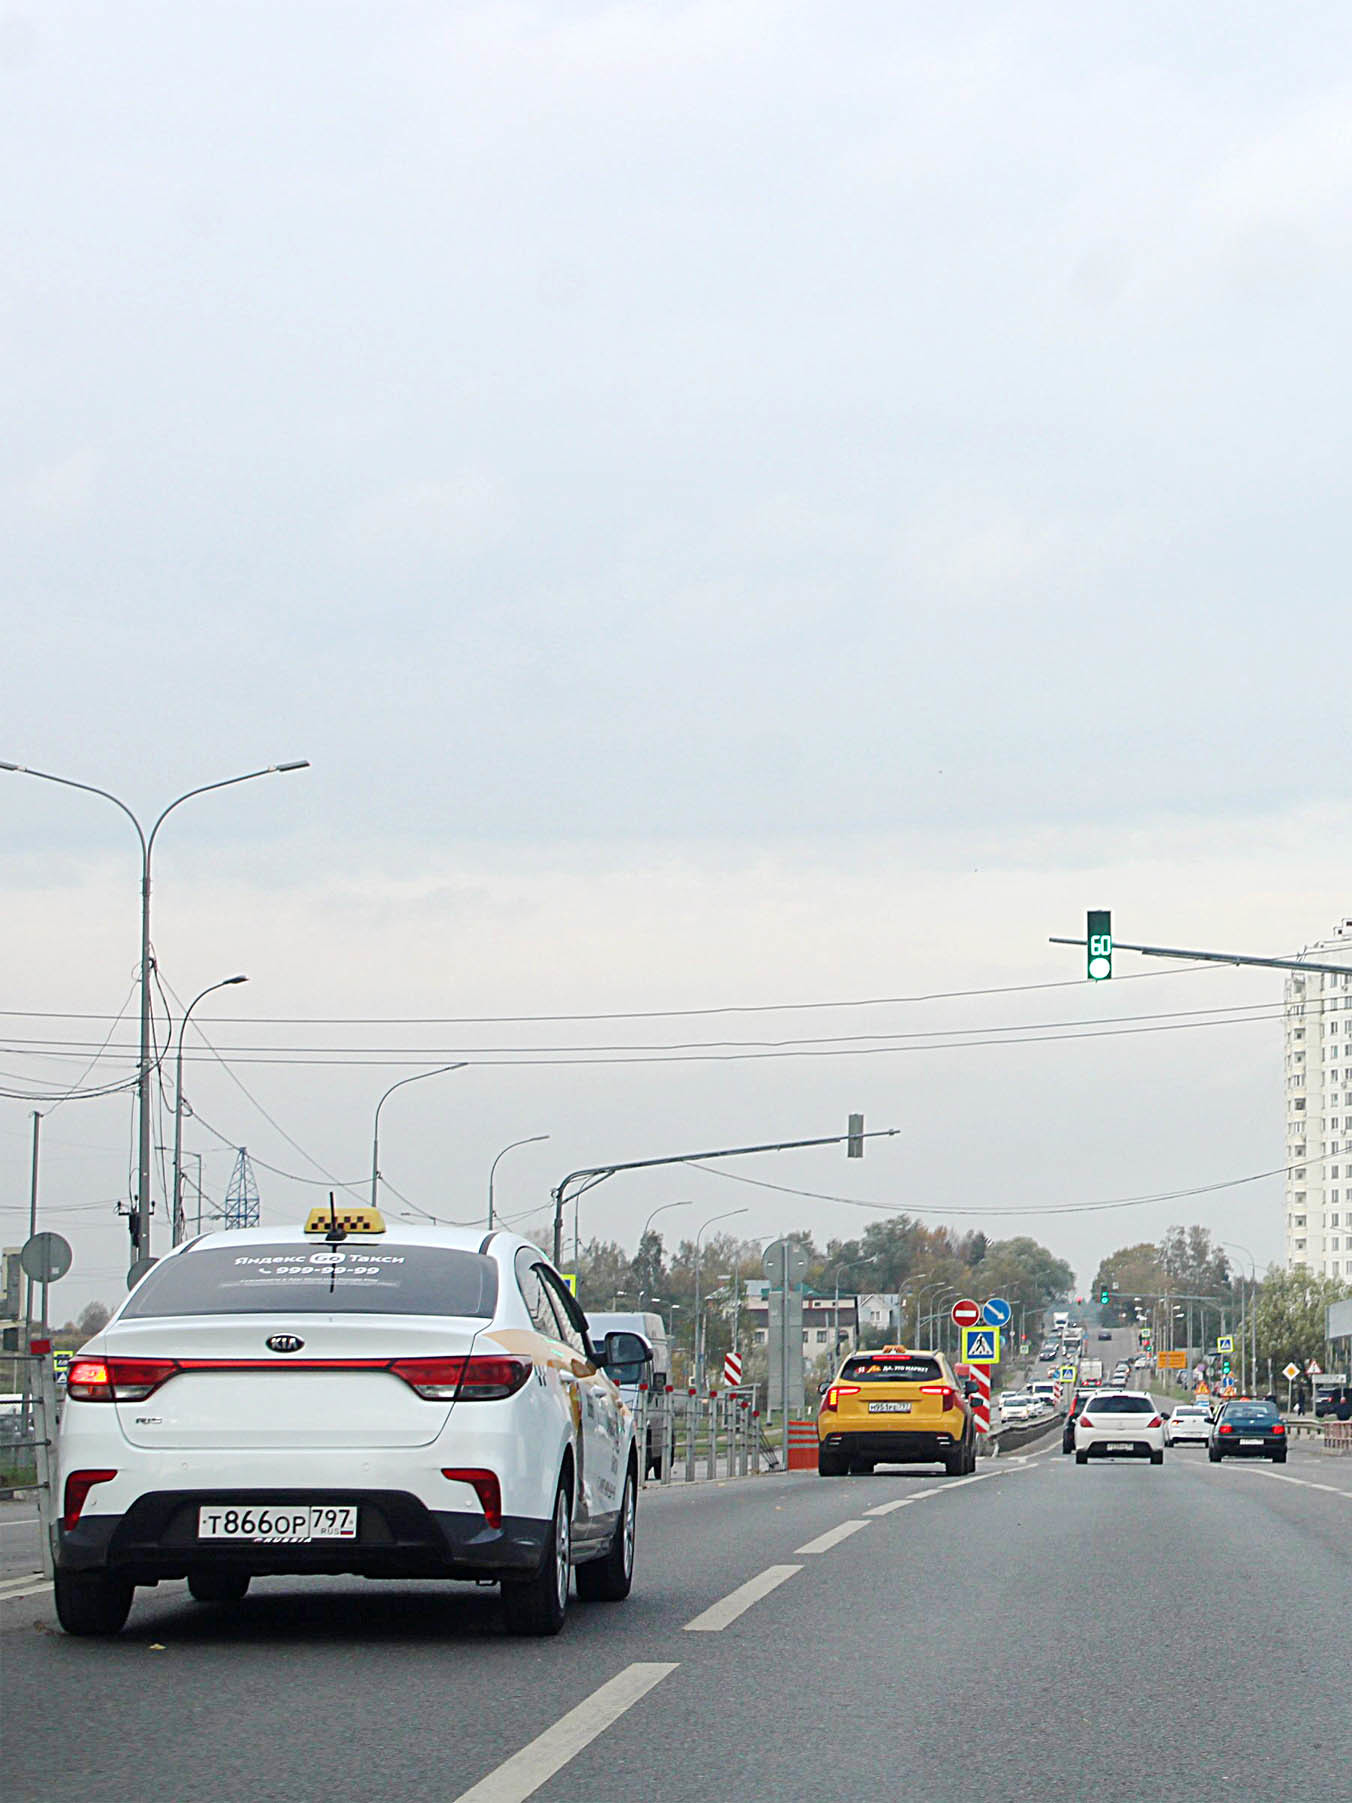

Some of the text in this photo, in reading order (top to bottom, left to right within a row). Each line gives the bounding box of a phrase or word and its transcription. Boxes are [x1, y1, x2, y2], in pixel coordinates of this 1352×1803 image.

[1091, 935, 1111, 955] 60
[233, 1254, 306, 1265] Яндекс
[349, 1254, 405, 1264] Такси
[276, 1266, 380, 1275] 999-99-99
[271, 1337, 298, 1350] KIA
[208, 1509, 350, 1534] Т866ОР 797
